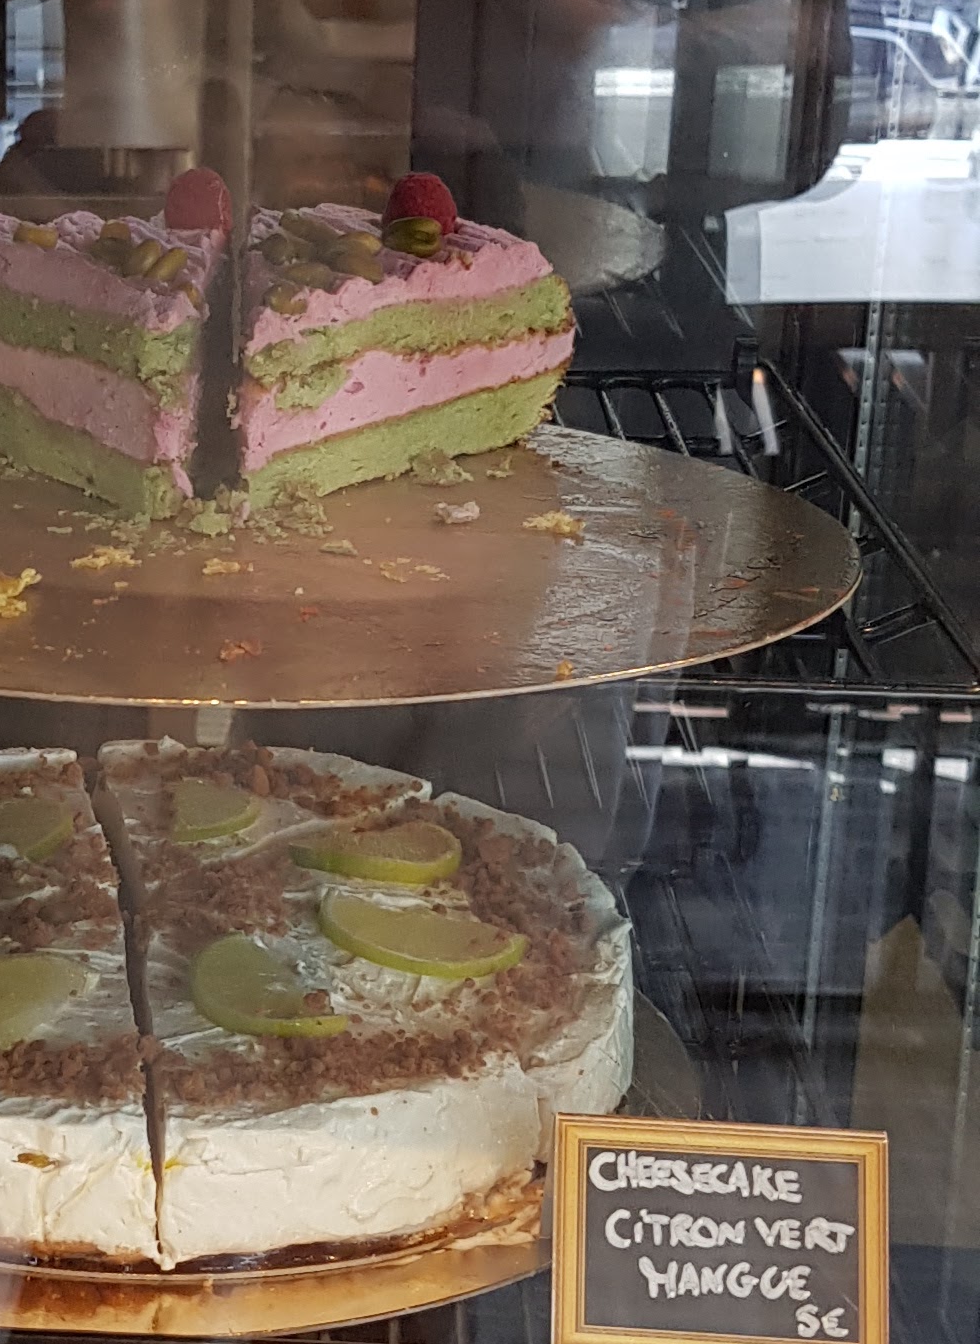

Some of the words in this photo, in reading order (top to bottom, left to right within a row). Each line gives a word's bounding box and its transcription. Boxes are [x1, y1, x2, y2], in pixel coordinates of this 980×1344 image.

[589, 1150, 802, 1203] CHEESECAKE
[754, 1217, 855, 1253] VERT
[639, 1257, 811, 1300] MANGUE
